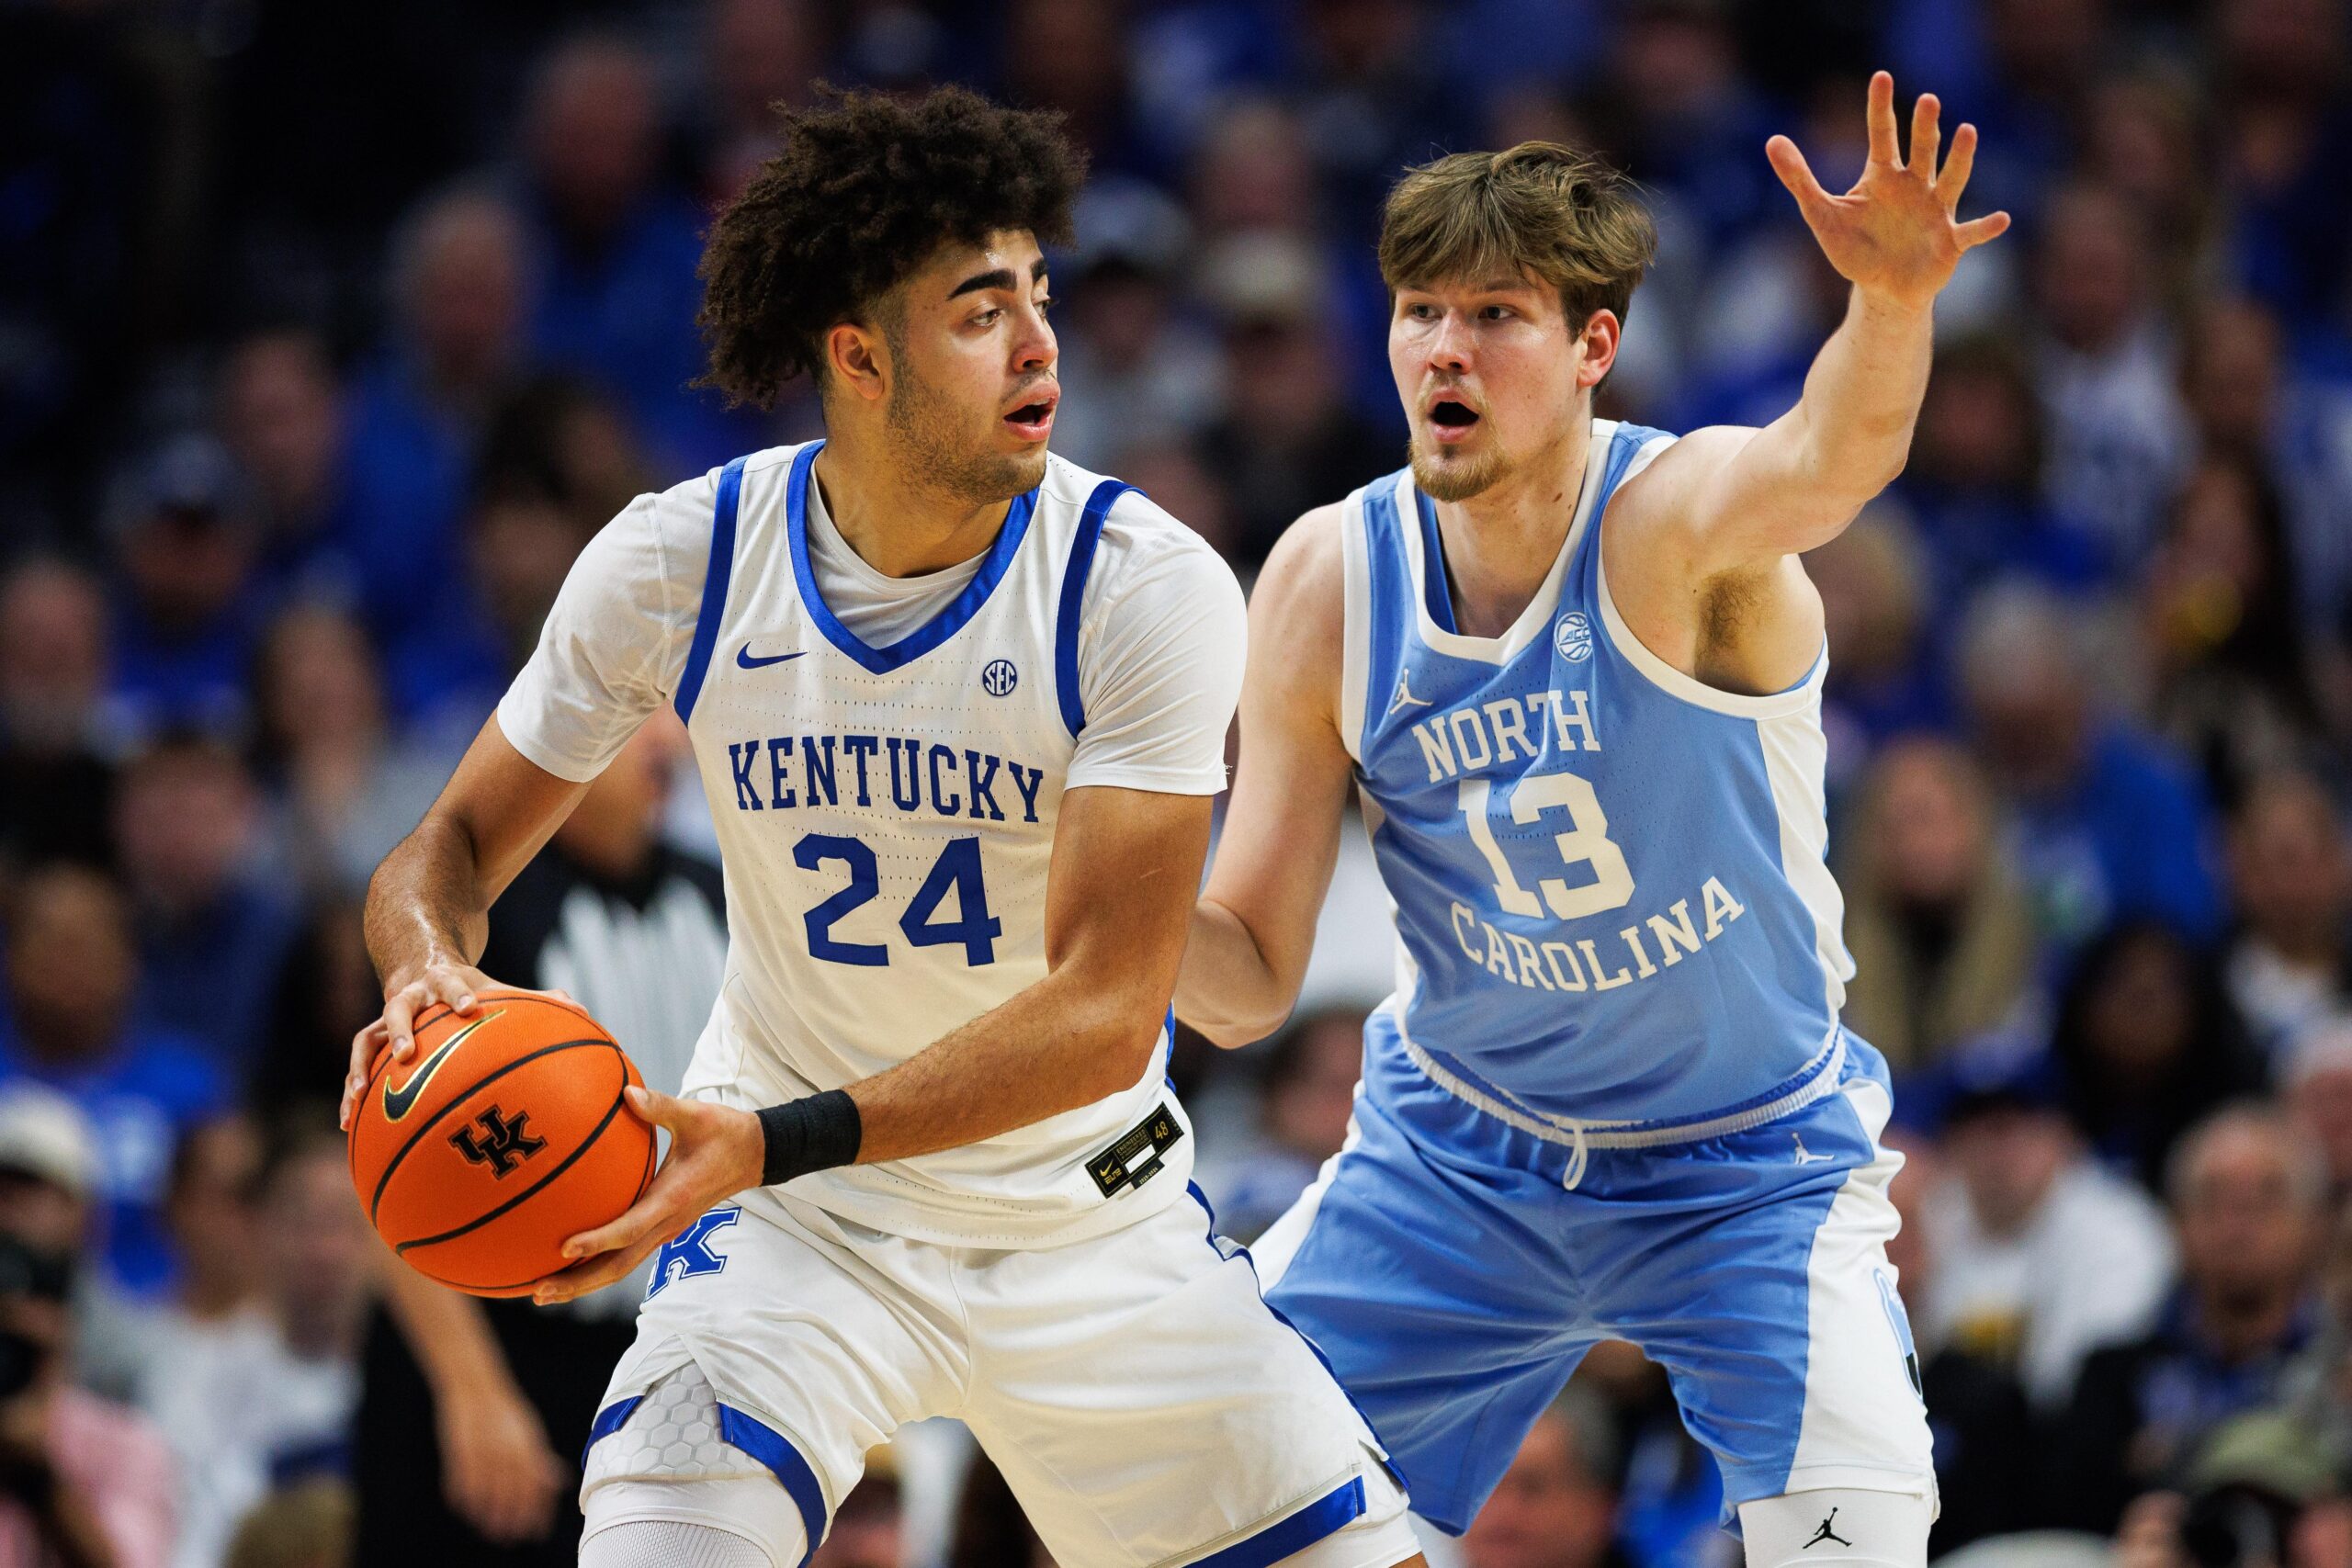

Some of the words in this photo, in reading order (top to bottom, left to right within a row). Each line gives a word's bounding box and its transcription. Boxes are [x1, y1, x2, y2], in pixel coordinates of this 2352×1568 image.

[983, 660, 1017, 696] SEC
[729, 735, 1044, 823] KENTUCKY
[1411, 690, 1601, 784] NORTH
[1458, 772, 1635, 920] 13
[792, 833, 1002, 966] 24
[1451, 875, 1745, 992] CAROLINA
[447, 1104, 548, 1180] UK
[1155, 1121, 1169, 1139] 48
